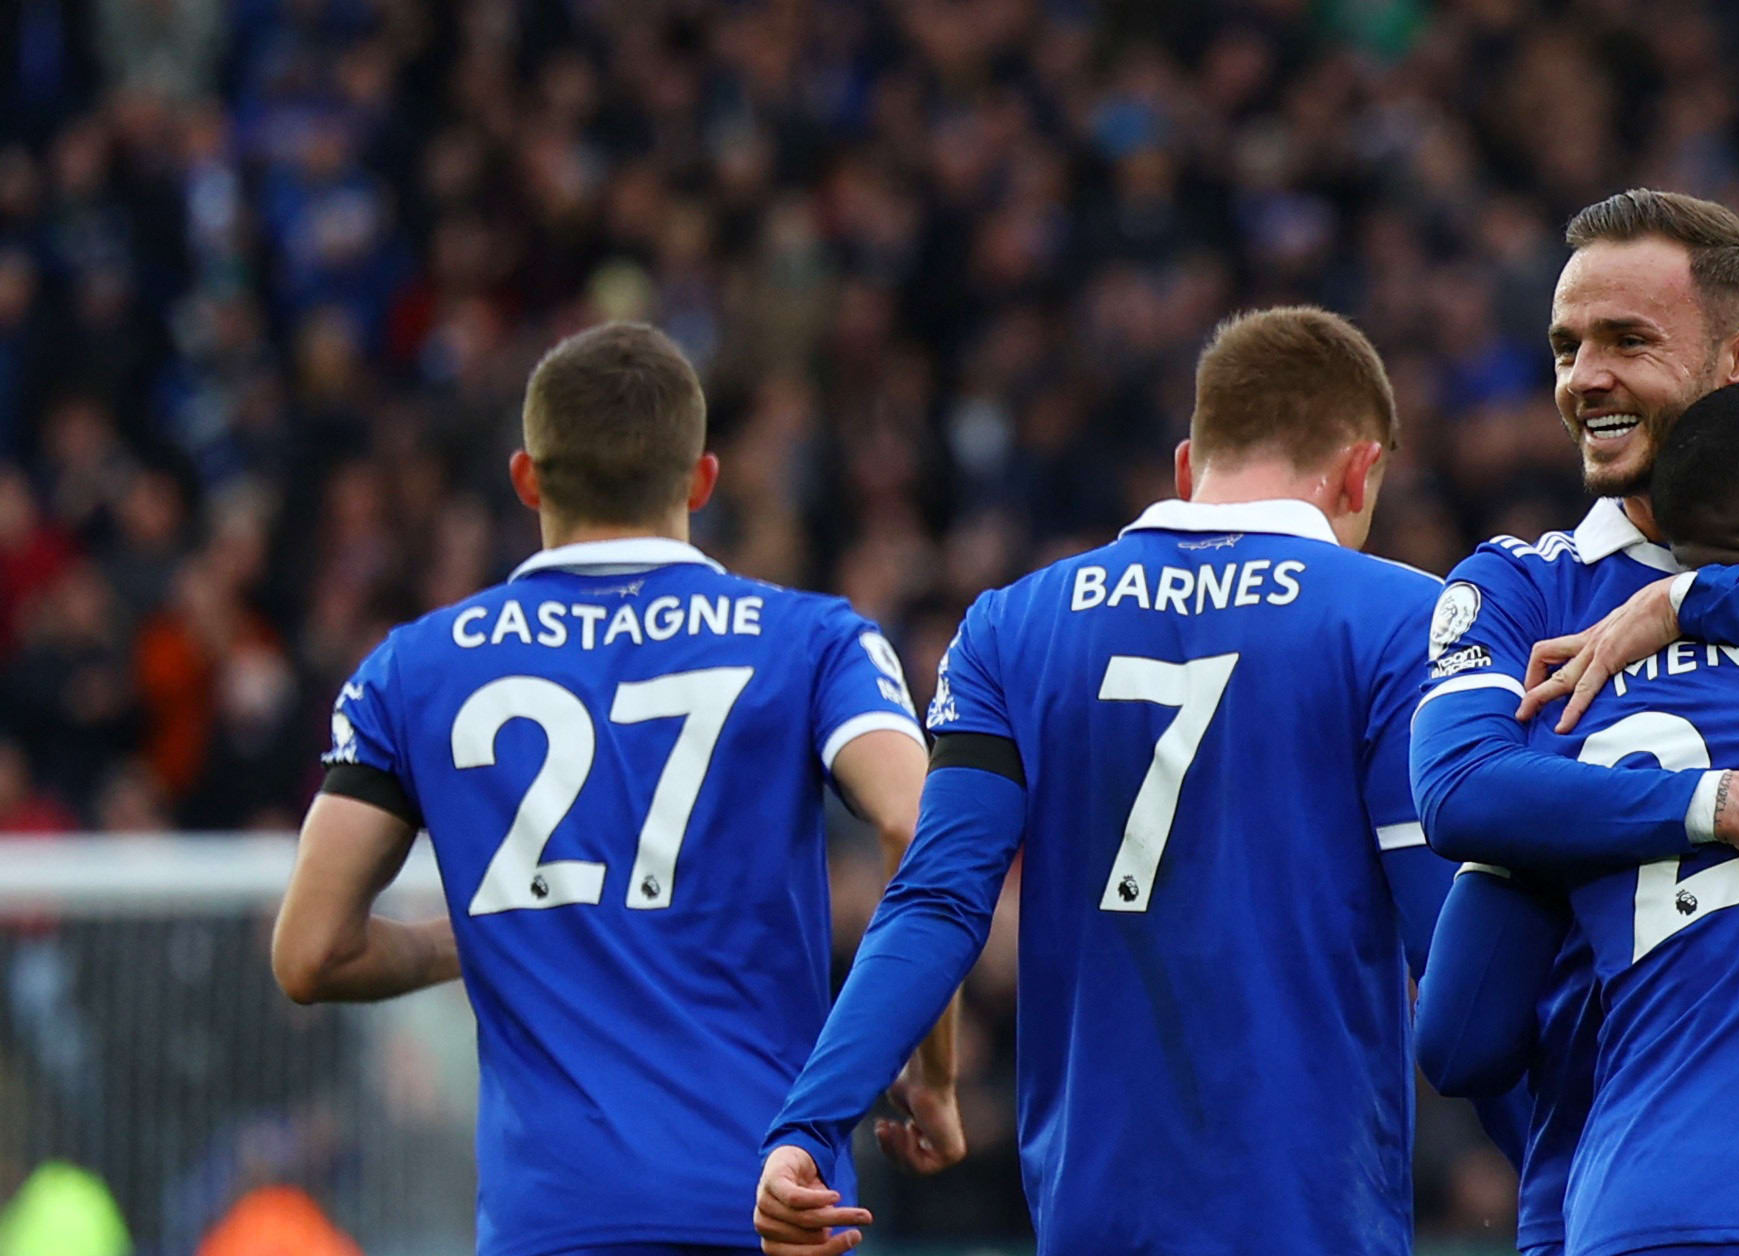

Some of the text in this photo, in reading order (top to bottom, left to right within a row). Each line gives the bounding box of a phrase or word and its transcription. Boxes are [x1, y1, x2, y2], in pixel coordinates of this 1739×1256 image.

[452, 595, 764, 650] CASTAGNE
[1071, 560, 1306, 616] BARNES
[452, 666, 755, 917] 27
[1098, 653, 1240, 912] 7
